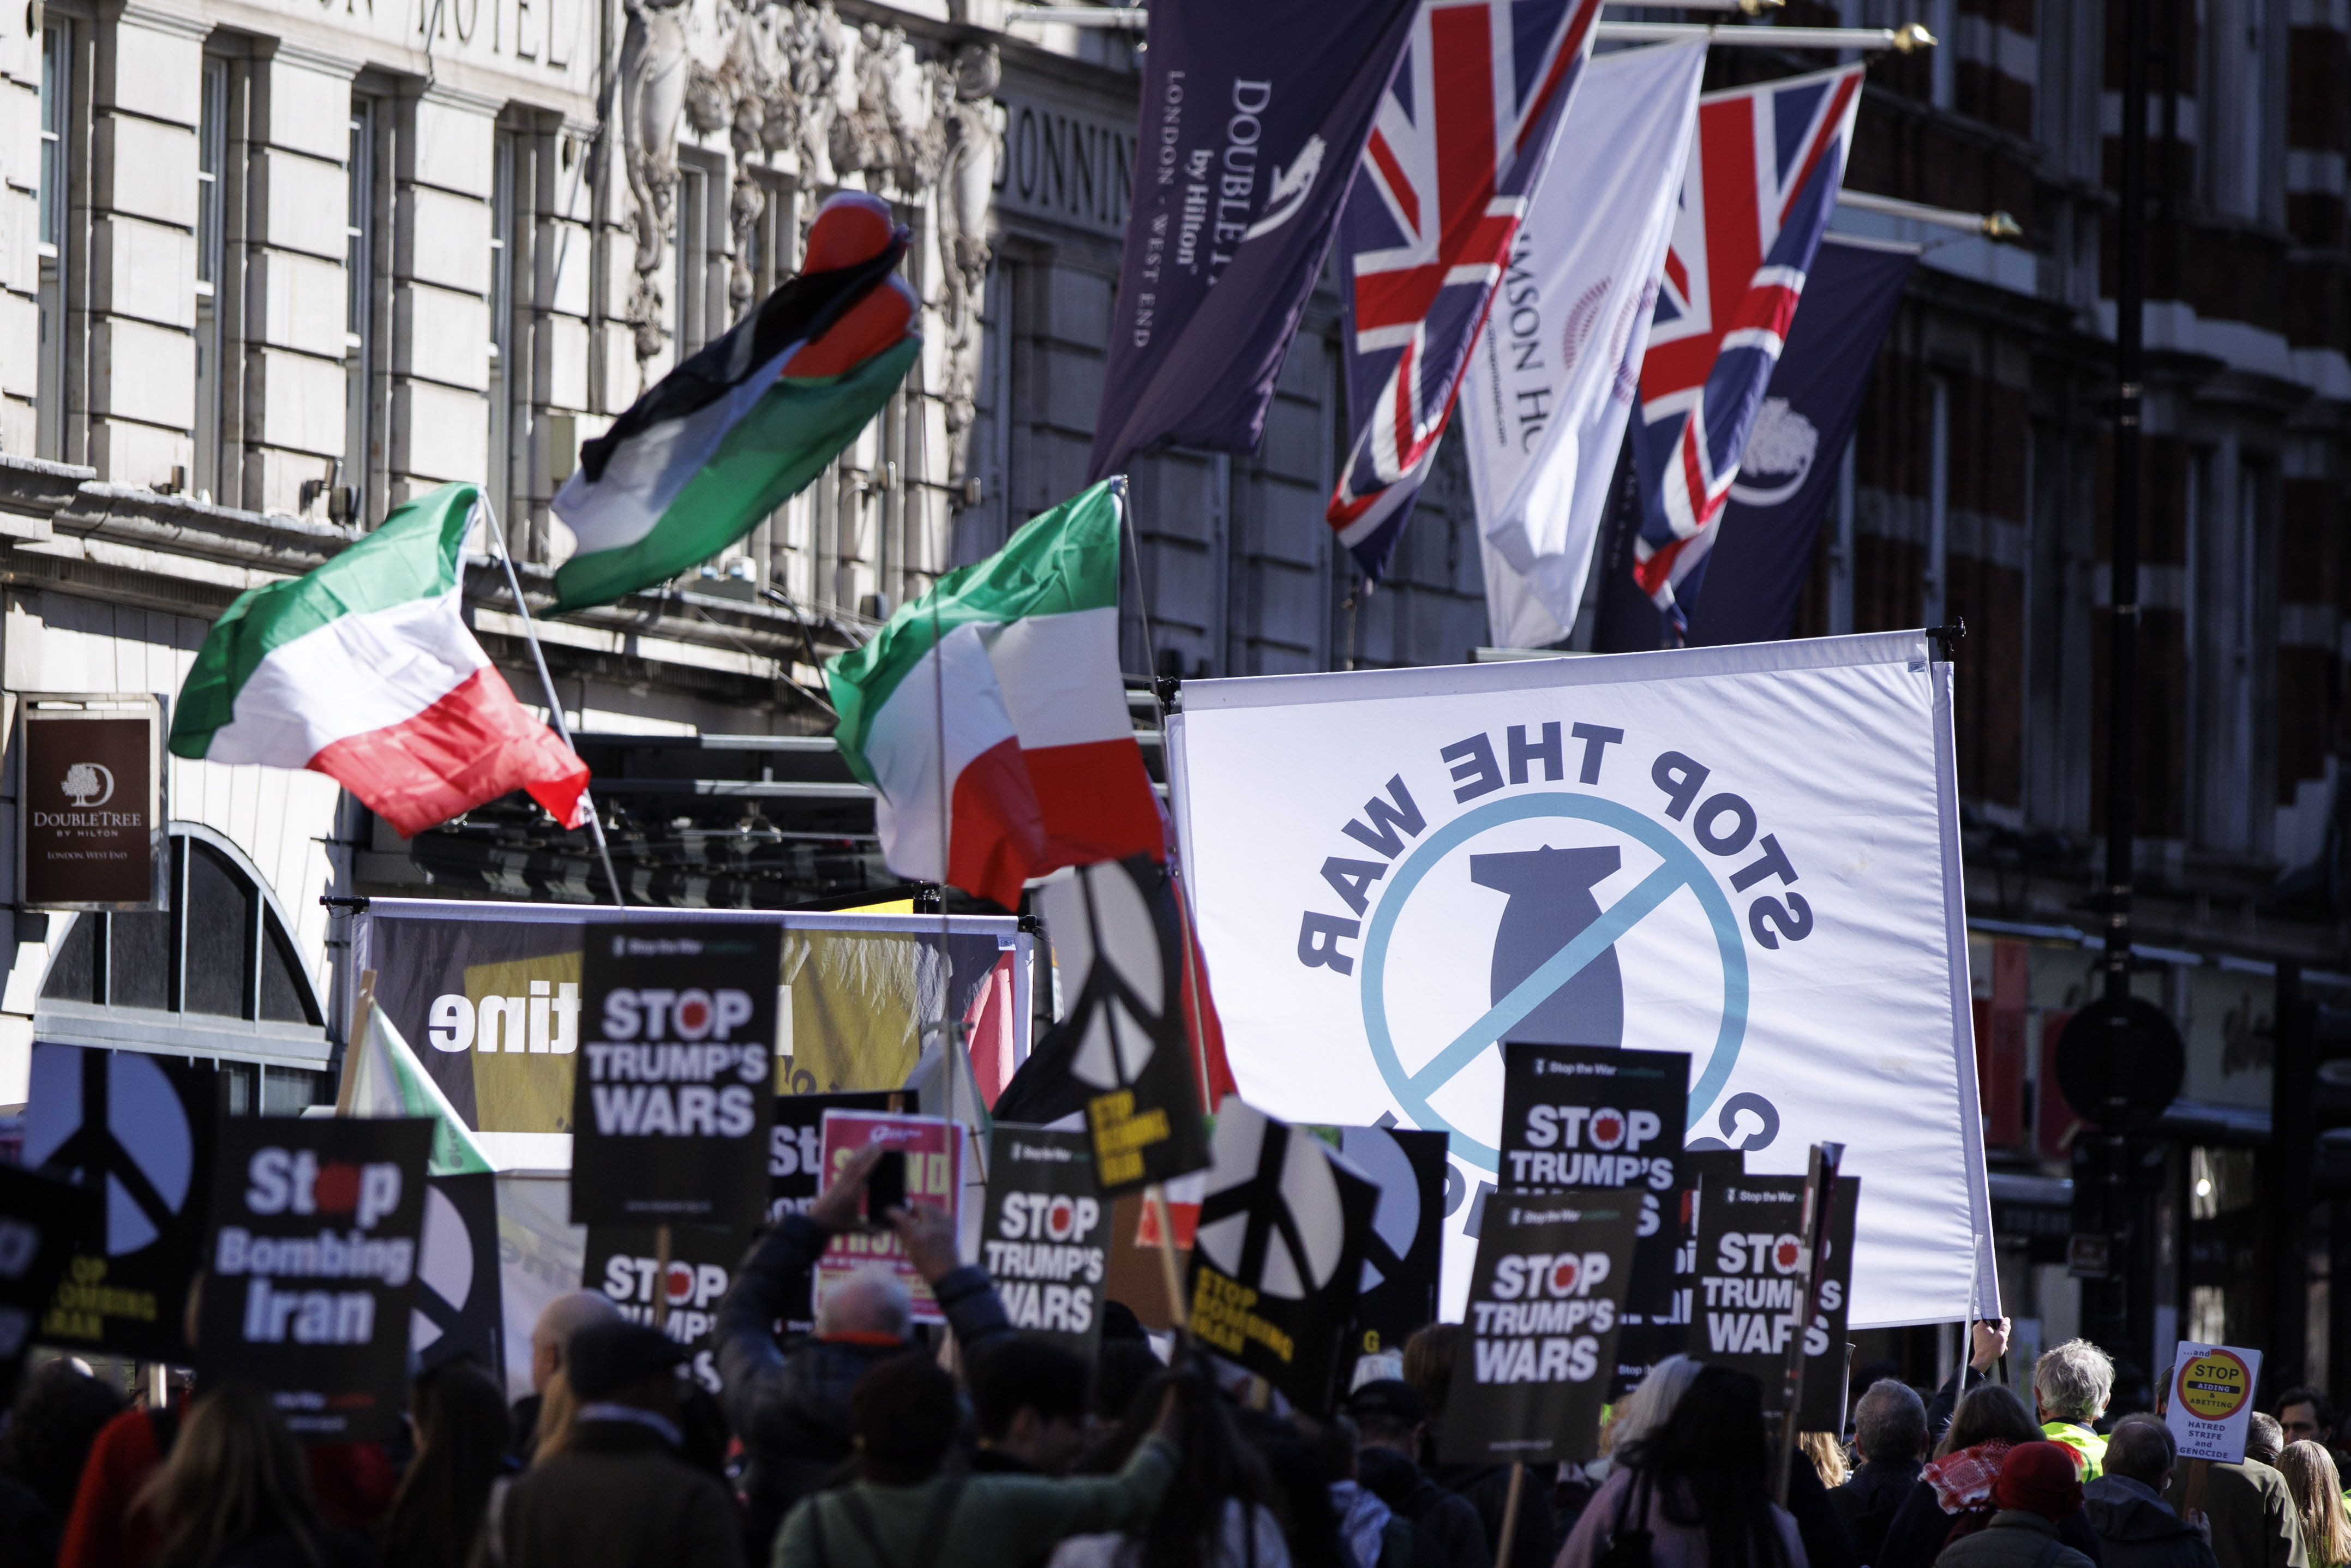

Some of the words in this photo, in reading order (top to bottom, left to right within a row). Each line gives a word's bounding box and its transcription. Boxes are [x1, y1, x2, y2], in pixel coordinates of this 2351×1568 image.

[1157, 70, 1185, 185] LONDON
[1184, 149, 1214, 181] by
[1206, 75, 1272, 286] DOUBLE
[1143, 213, 1169, 284] WEST
[1133, 293, 1156, 347] END
[1504, 233, 1545, 373] MSON
[85, 850, 107, 860] WEST
[109, 850, 128, 860] END
[602, 987, 753, 1041] STOP
[584, 1042, 769, 1084] TRUMP'S
[591, 1084, 756, 1138] WARS
[1525, 1104, 1662, 1152] STOP
[245, 1145, 405, 1231] Stp
[832, 1147, 950, 1195] SND
[1509, 1150, 1675, 1191] TRUMP'S
[1000, 1191, 1099, 1242] STOP
[216, 1225, 415, 1288] Bombing
[986, 1240, 1104, 1284] TRUMP'S
[1491, 1252, 1610, 1300] STOP
[1716, 1231, 1832, 1275] STO
[603, 1254, 729, 1308] STOP
[1701, 1276, 1843, 1311] TRUMS
[241, 1276, 378, 1345] Iran
[1473, 1299, 1616, 1337] TRUMP'S
[1474, 1336, 1600, 1385] WARS
[2195, 1365, 2239, 1380] STOP
[2190, 1398, 2233, 1409] ABETTING
[2197, 1383, 2230, 1392] AIDING
[2188, 1421, 2226, 1432] HATRED
[2188, 1431, 2222, 1440] STRIFE
[2179, 1447, 2229, 1459] GENOCIDE
